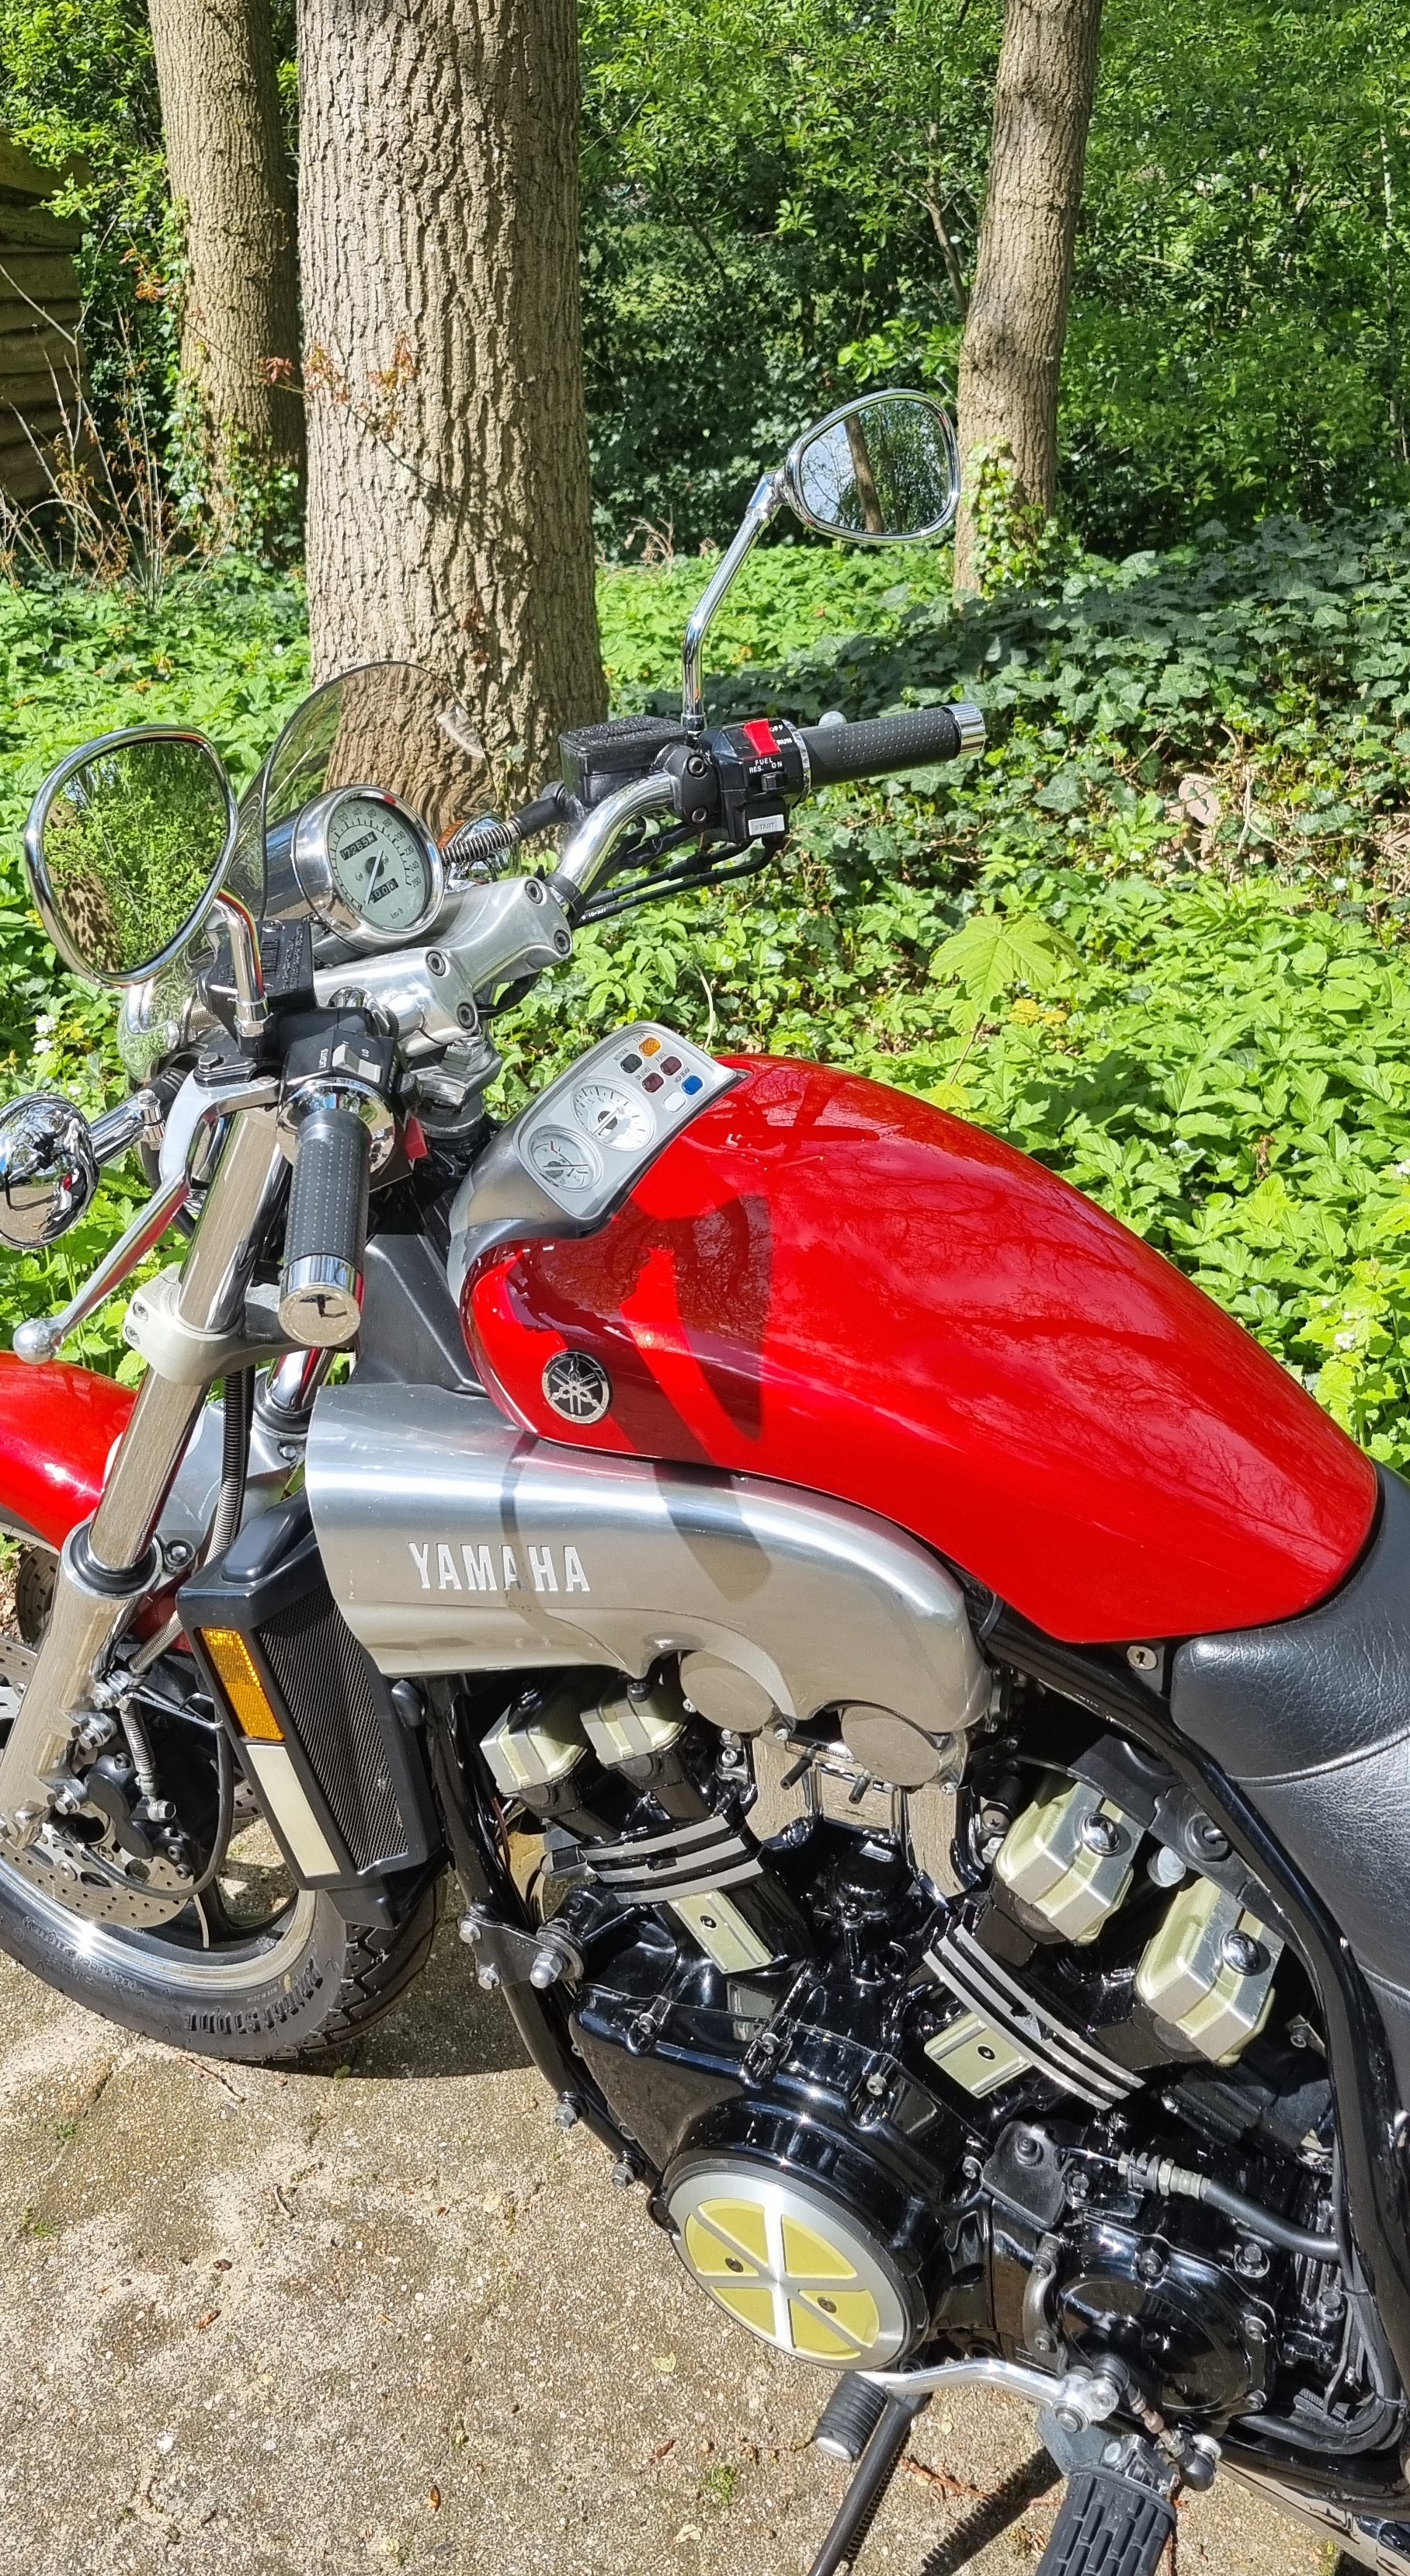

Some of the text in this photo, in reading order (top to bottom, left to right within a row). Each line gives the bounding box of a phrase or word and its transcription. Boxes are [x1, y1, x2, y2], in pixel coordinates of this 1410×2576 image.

[755, 756, 773, 766] FUEL
[338, 812, 348, 822] 120
[755, 821, 776, 831] START
[394, 830, 406, 841] 200
[404, 845, 415, 856] 220
[409, 860, 420, 871] 240
[318, 1048, 329, 1069] LIGHTS
[408, 1541, 591, 1593] YAMAHA
